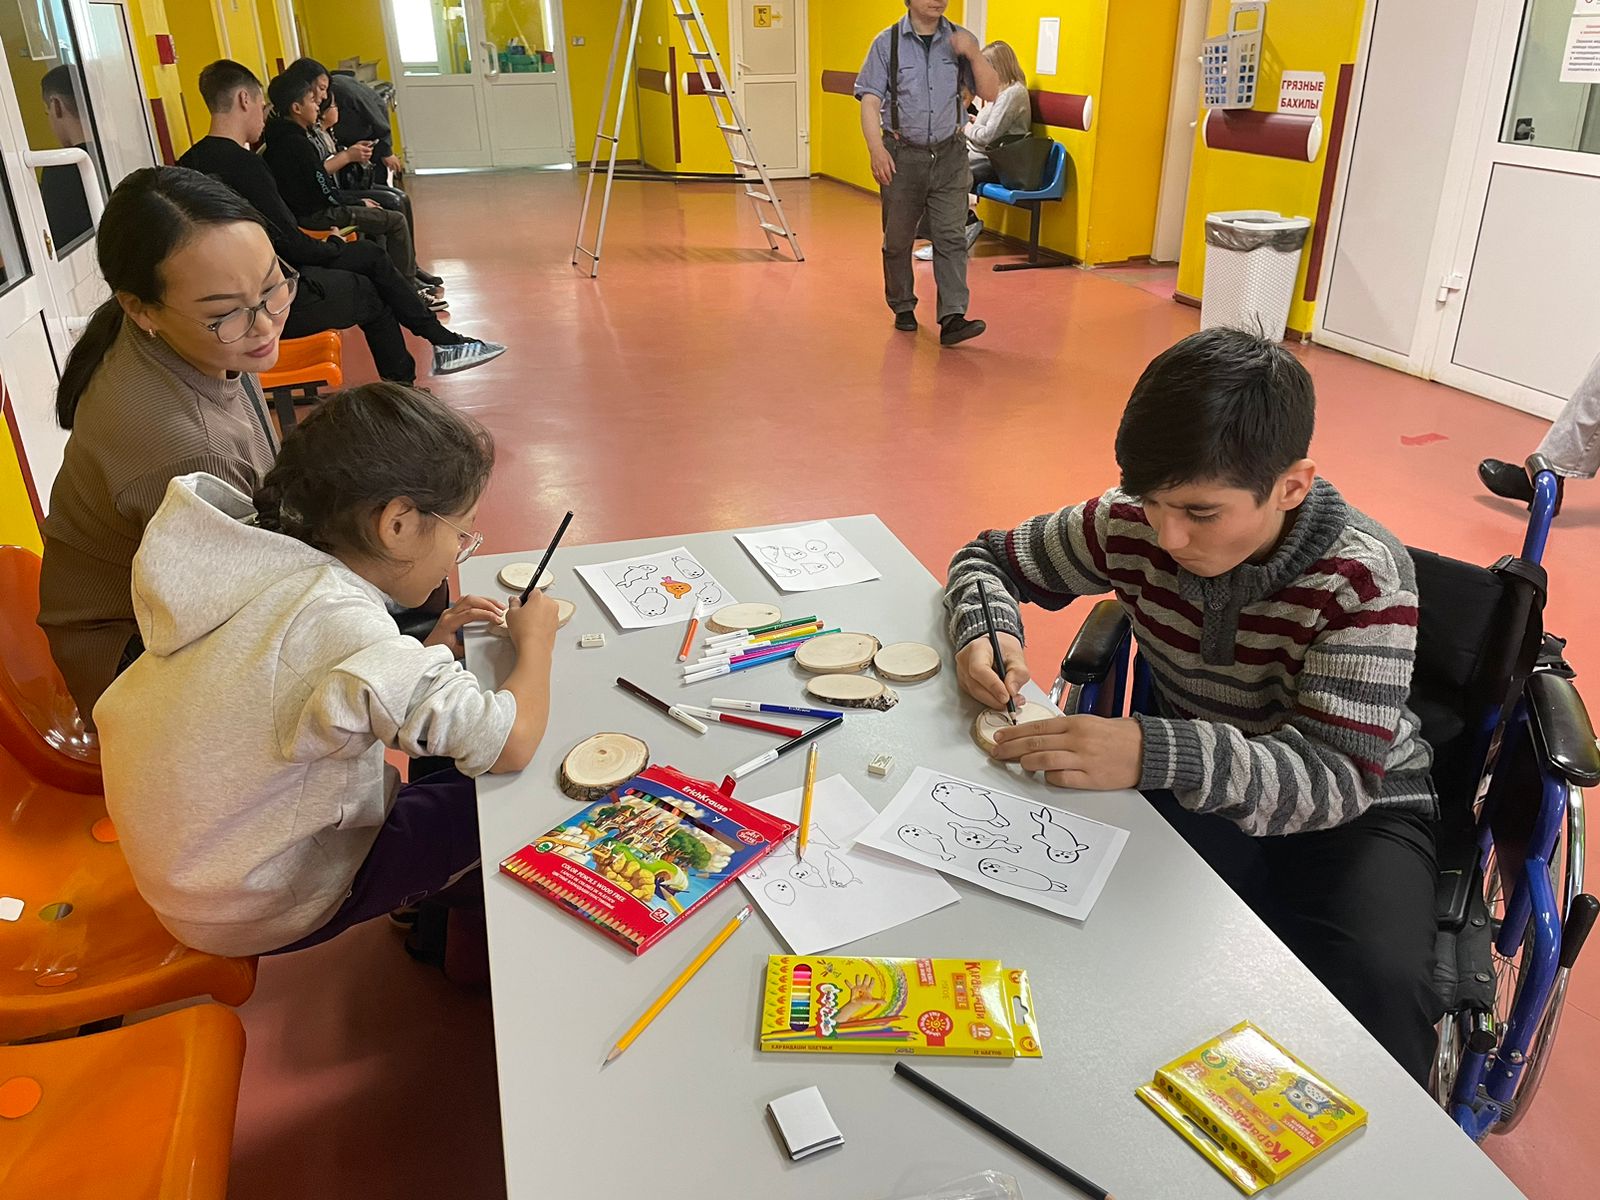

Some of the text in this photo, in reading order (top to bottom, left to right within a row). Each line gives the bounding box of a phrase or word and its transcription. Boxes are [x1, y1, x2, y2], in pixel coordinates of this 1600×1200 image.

[1281, 80, 1324, 92] ГРЯЗНЫЕ
[1280, 97, 1319, 109] БАХИЛЫ
[682, 786, 728, 812] ErichKrause
[561, 863, 626, 902] COLOR PENCILS WOOD FREE
[654, 909, 667, 918] 24
[977, 1026, 991, 1037] 12
